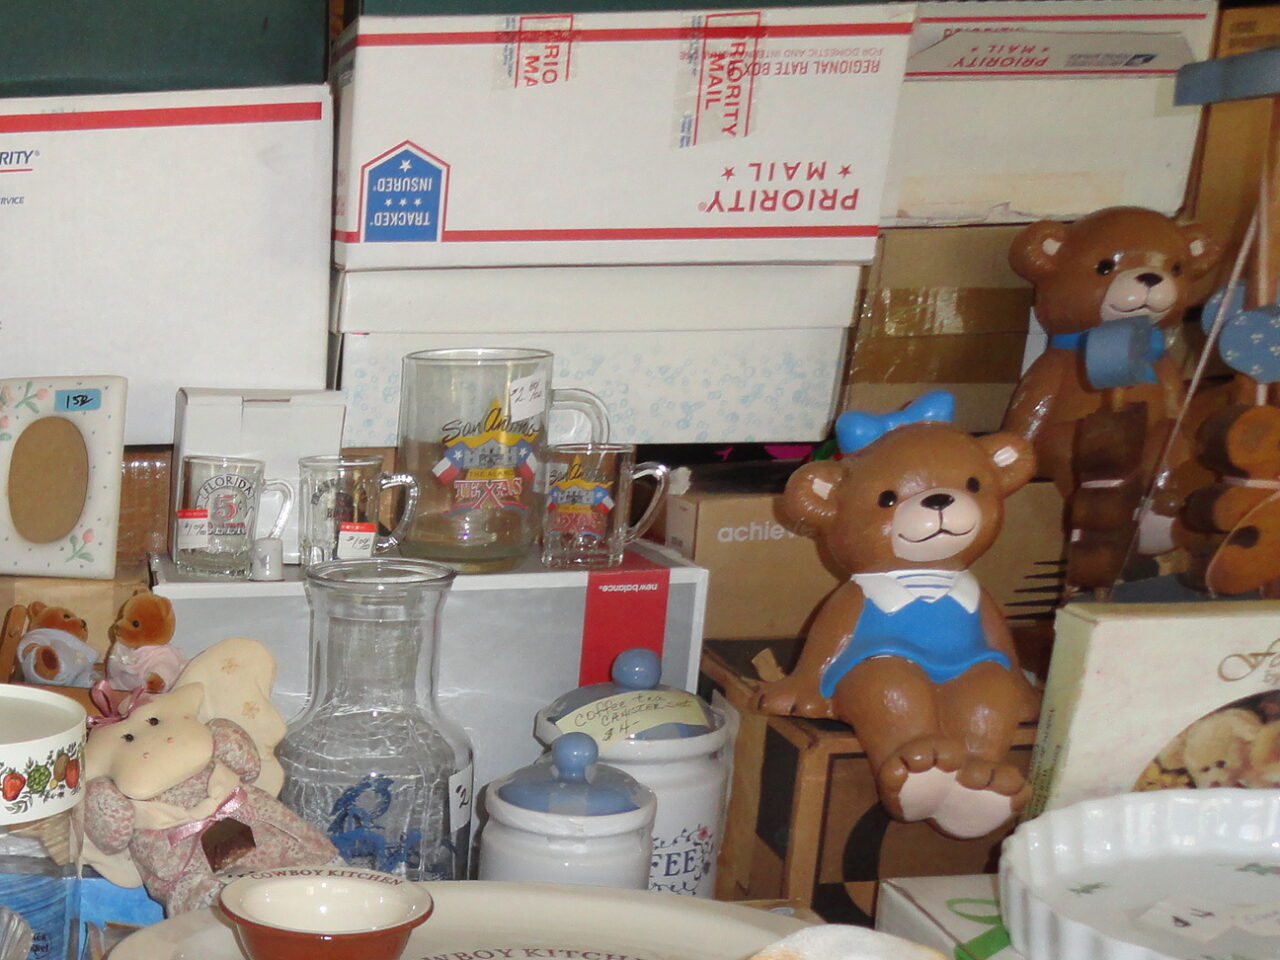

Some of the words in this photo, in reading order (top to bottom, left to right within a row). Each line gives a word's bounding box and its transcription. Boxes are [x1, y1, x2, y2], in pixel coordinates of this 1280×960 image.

[775, 61, 809, 75] RATE
[814, 60, 880, 75] REGIONAL
[953, 57, 1050, 68] PRIORITY
[704, 52, 724, 111] MAIL
[721, 38, 748, 137] RIORITY
[748, 161, 827, 182] MAIL
[376, 177, 433, 192] INSURED
[704, 188, 860, 213] PRIORITY
[373, 211, 431, 226] TRACKED
[441, 418, 482, 444] San
[203, 474, 253, 500] FLORIDA
[453, 478, 524, 509] TEXAS
[574, 698, 628, 728] Coffee
[251, 868, 322, 881] COWBOY
[327, 869, 403, 887] KITCHEN
